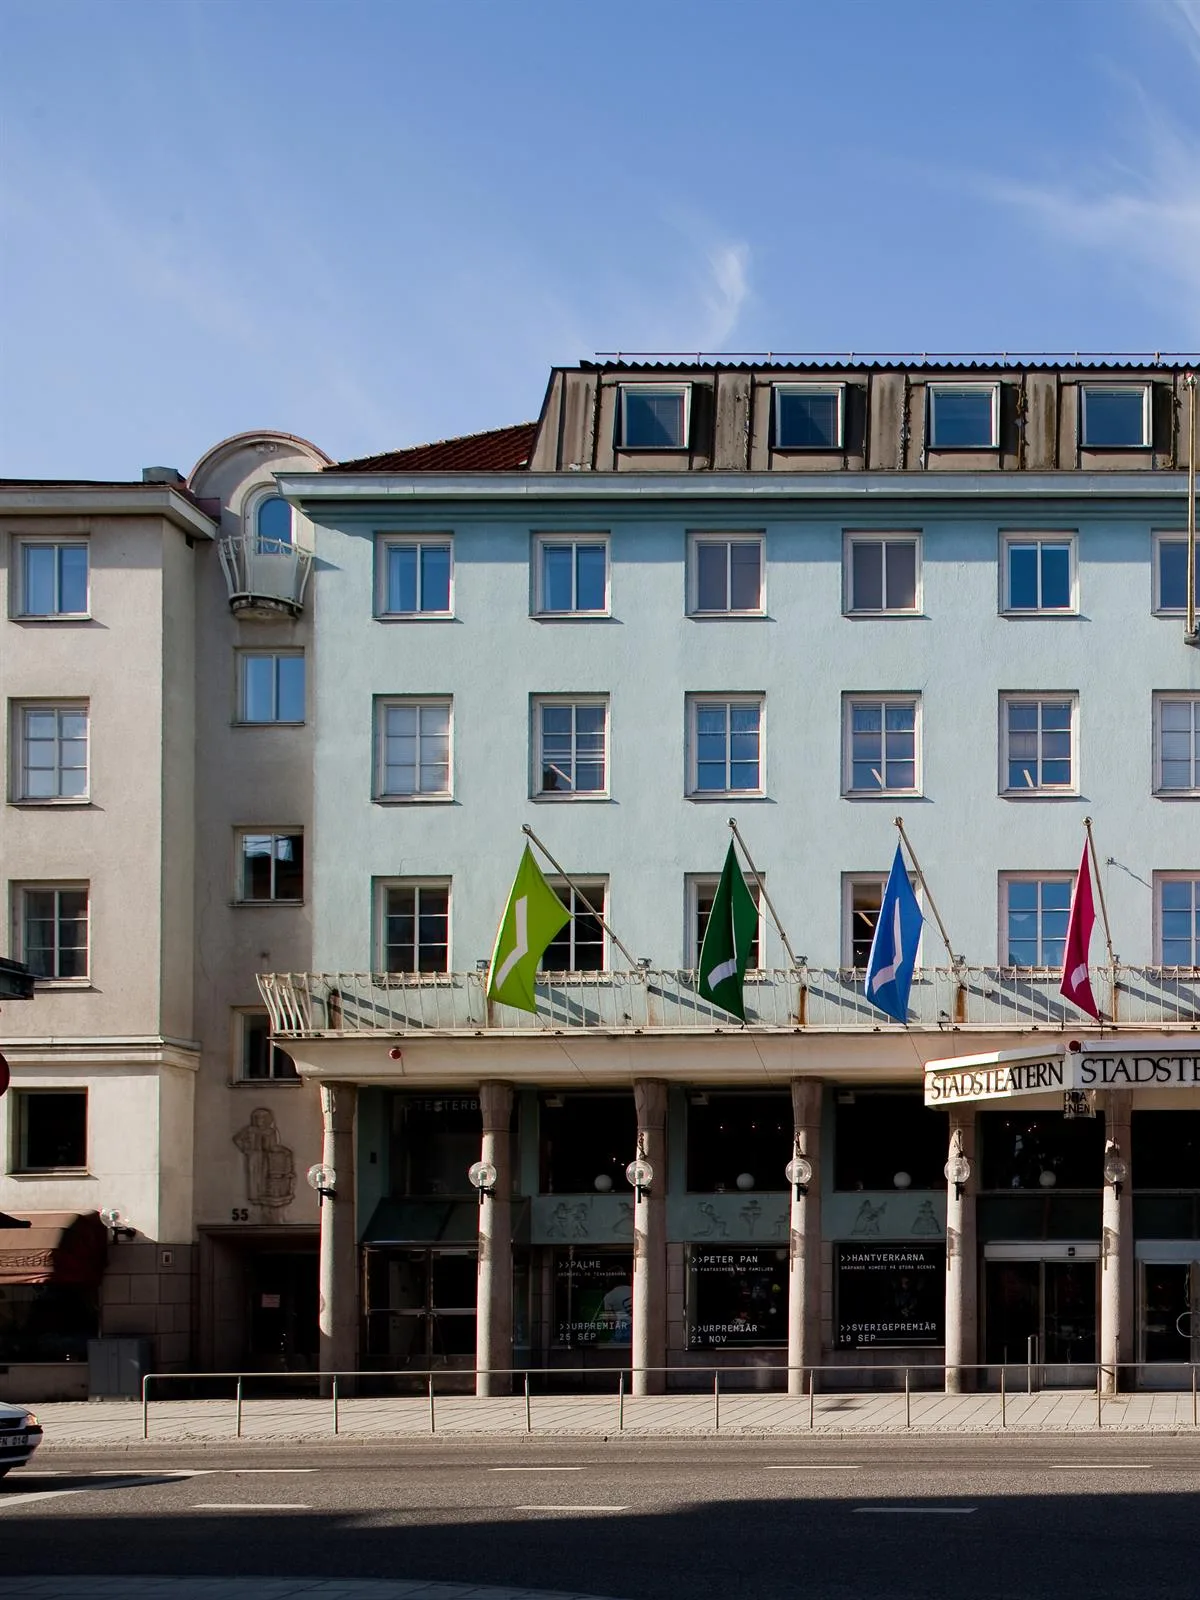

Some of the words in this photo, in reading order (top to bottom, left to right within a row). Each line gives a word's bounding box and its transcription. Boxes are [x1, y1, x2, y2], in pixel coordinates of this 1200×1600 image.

[931, 1060, 1065, 1100] STADSTEATERN
[232, 1208, 249, 1221] 55
[740, 1255, 758, 1264] PAN
[709, 1335, 727, 1343] NOV
